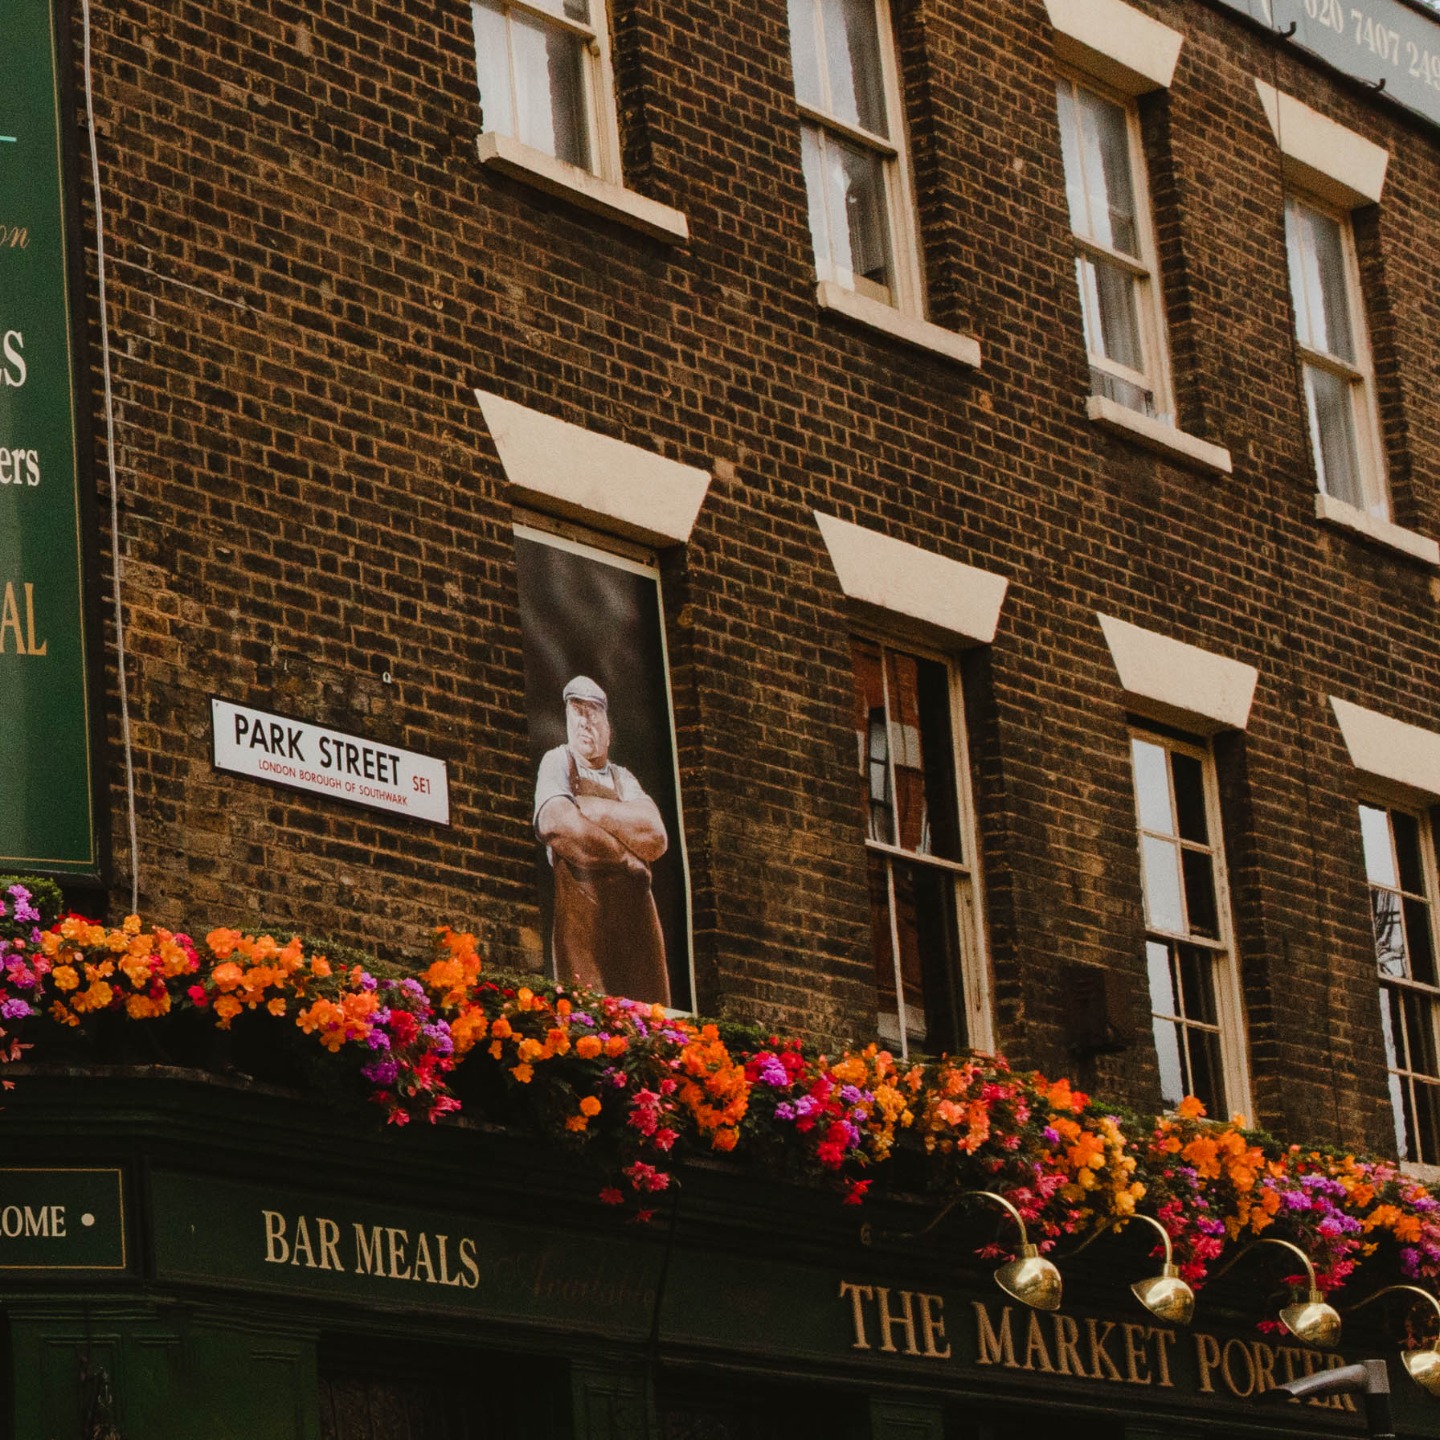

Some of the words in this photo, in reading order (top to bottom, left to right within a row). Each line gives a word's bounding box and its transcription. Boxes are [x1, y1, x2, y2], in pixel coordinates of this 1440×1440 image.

[1351, 8, 1400, 66] 7407
[234, 713, 305, 762] PARK
[319, 736, 400, 786] STREET
[412, 775, 431, 795] SE1
[258, 759, 296, 778] LONDON
[299, 771, 342, 790] BOROUGH
[345, 781, 356, 793] OF
[359, 785, 408, 806] SOUTHWARK
[261, 1210, 345, 1272] BAR
[352, 1223, 480, 1289] MEALS
[839, 1280, 951, 1359] THE
[971, 1300, 1176, 1388] MARKET
